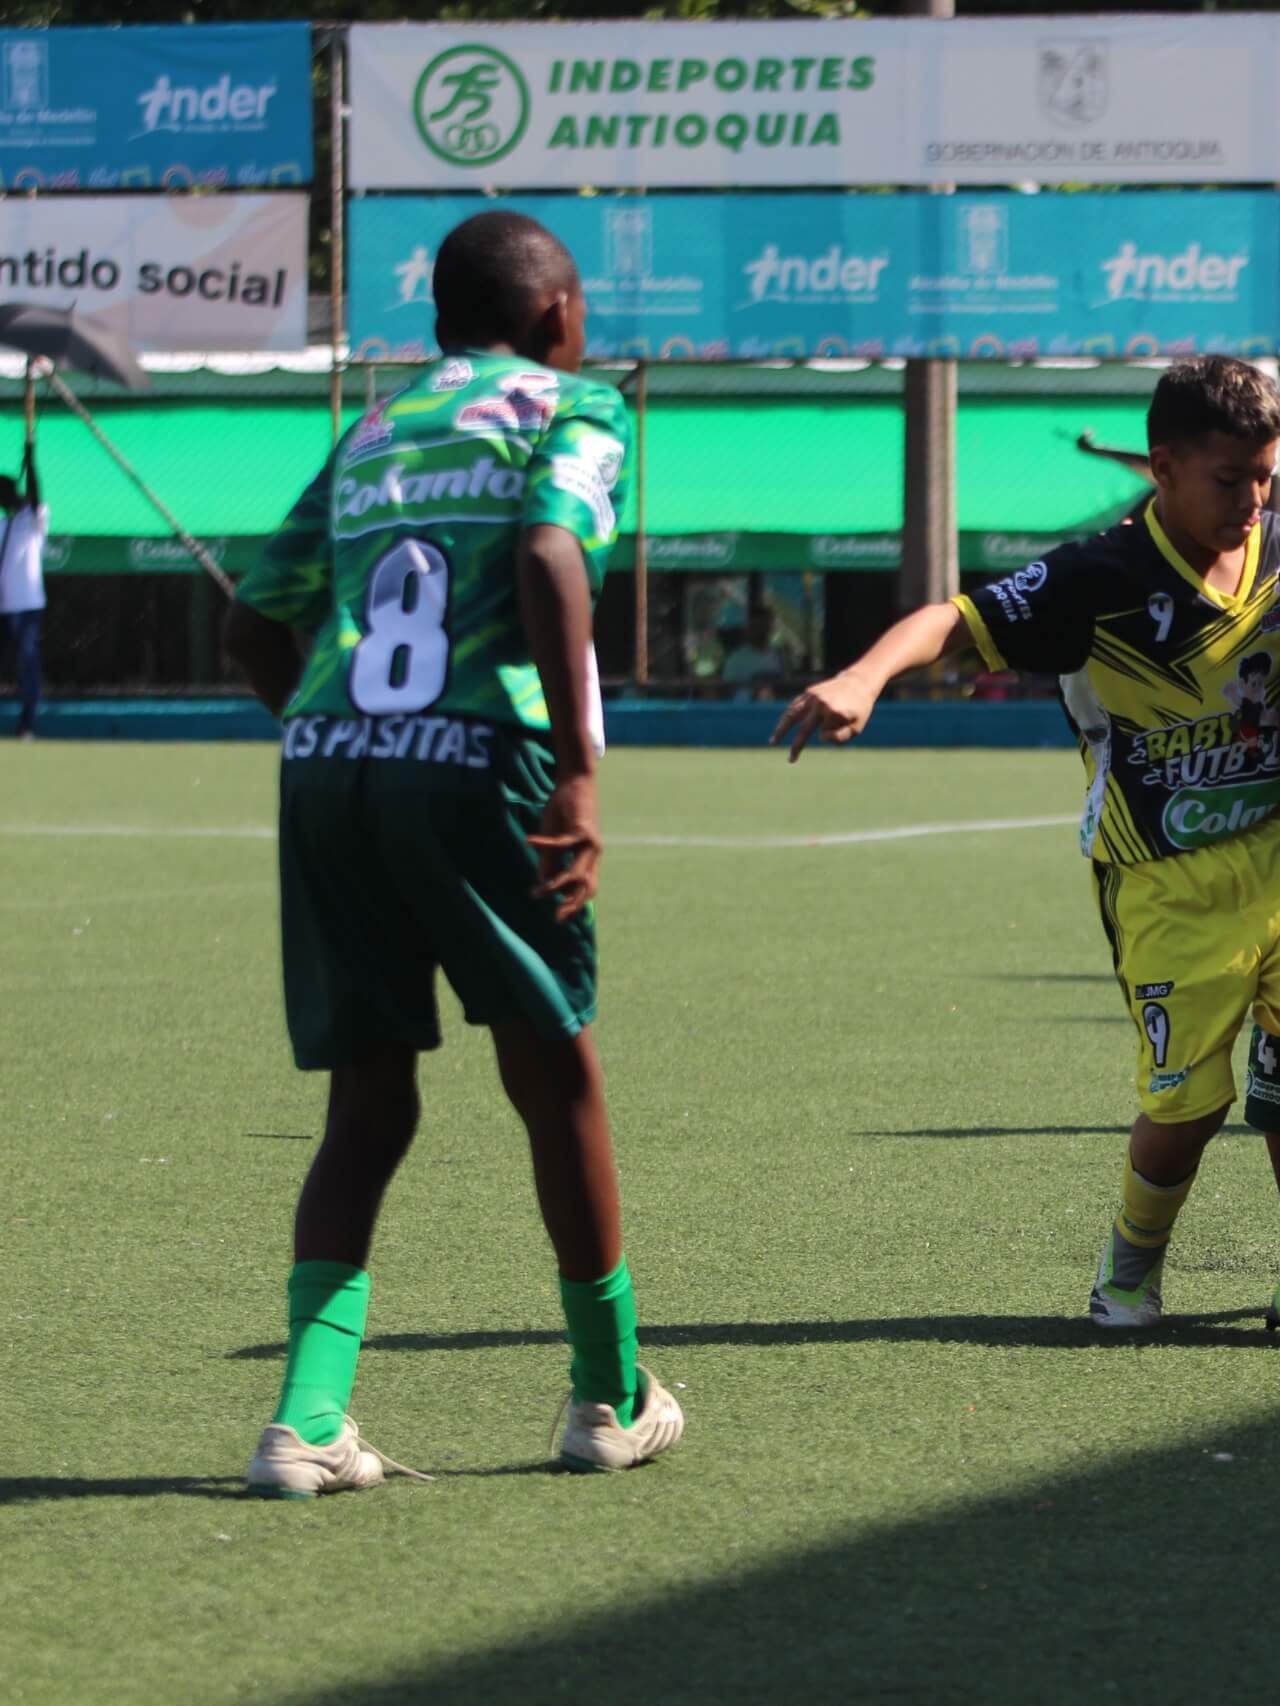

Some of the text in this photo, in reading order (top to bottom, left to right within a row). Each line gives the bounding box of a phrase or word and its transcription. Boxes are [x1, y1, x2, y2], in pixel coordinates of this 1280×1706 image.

[547, 57, 877, 93] INDEPORTES
[547, 112, 842, 152] ANTIOQUIA
[1081, 143, 1107, 161] DE
[138, 259, 288, 308] social
[339, 456, 526, 516] Colanta
[353, 537, 449, 715] 8
[1148, 591, 1174, 642] 9
[1143, 1002, 1170, 1068] 9
